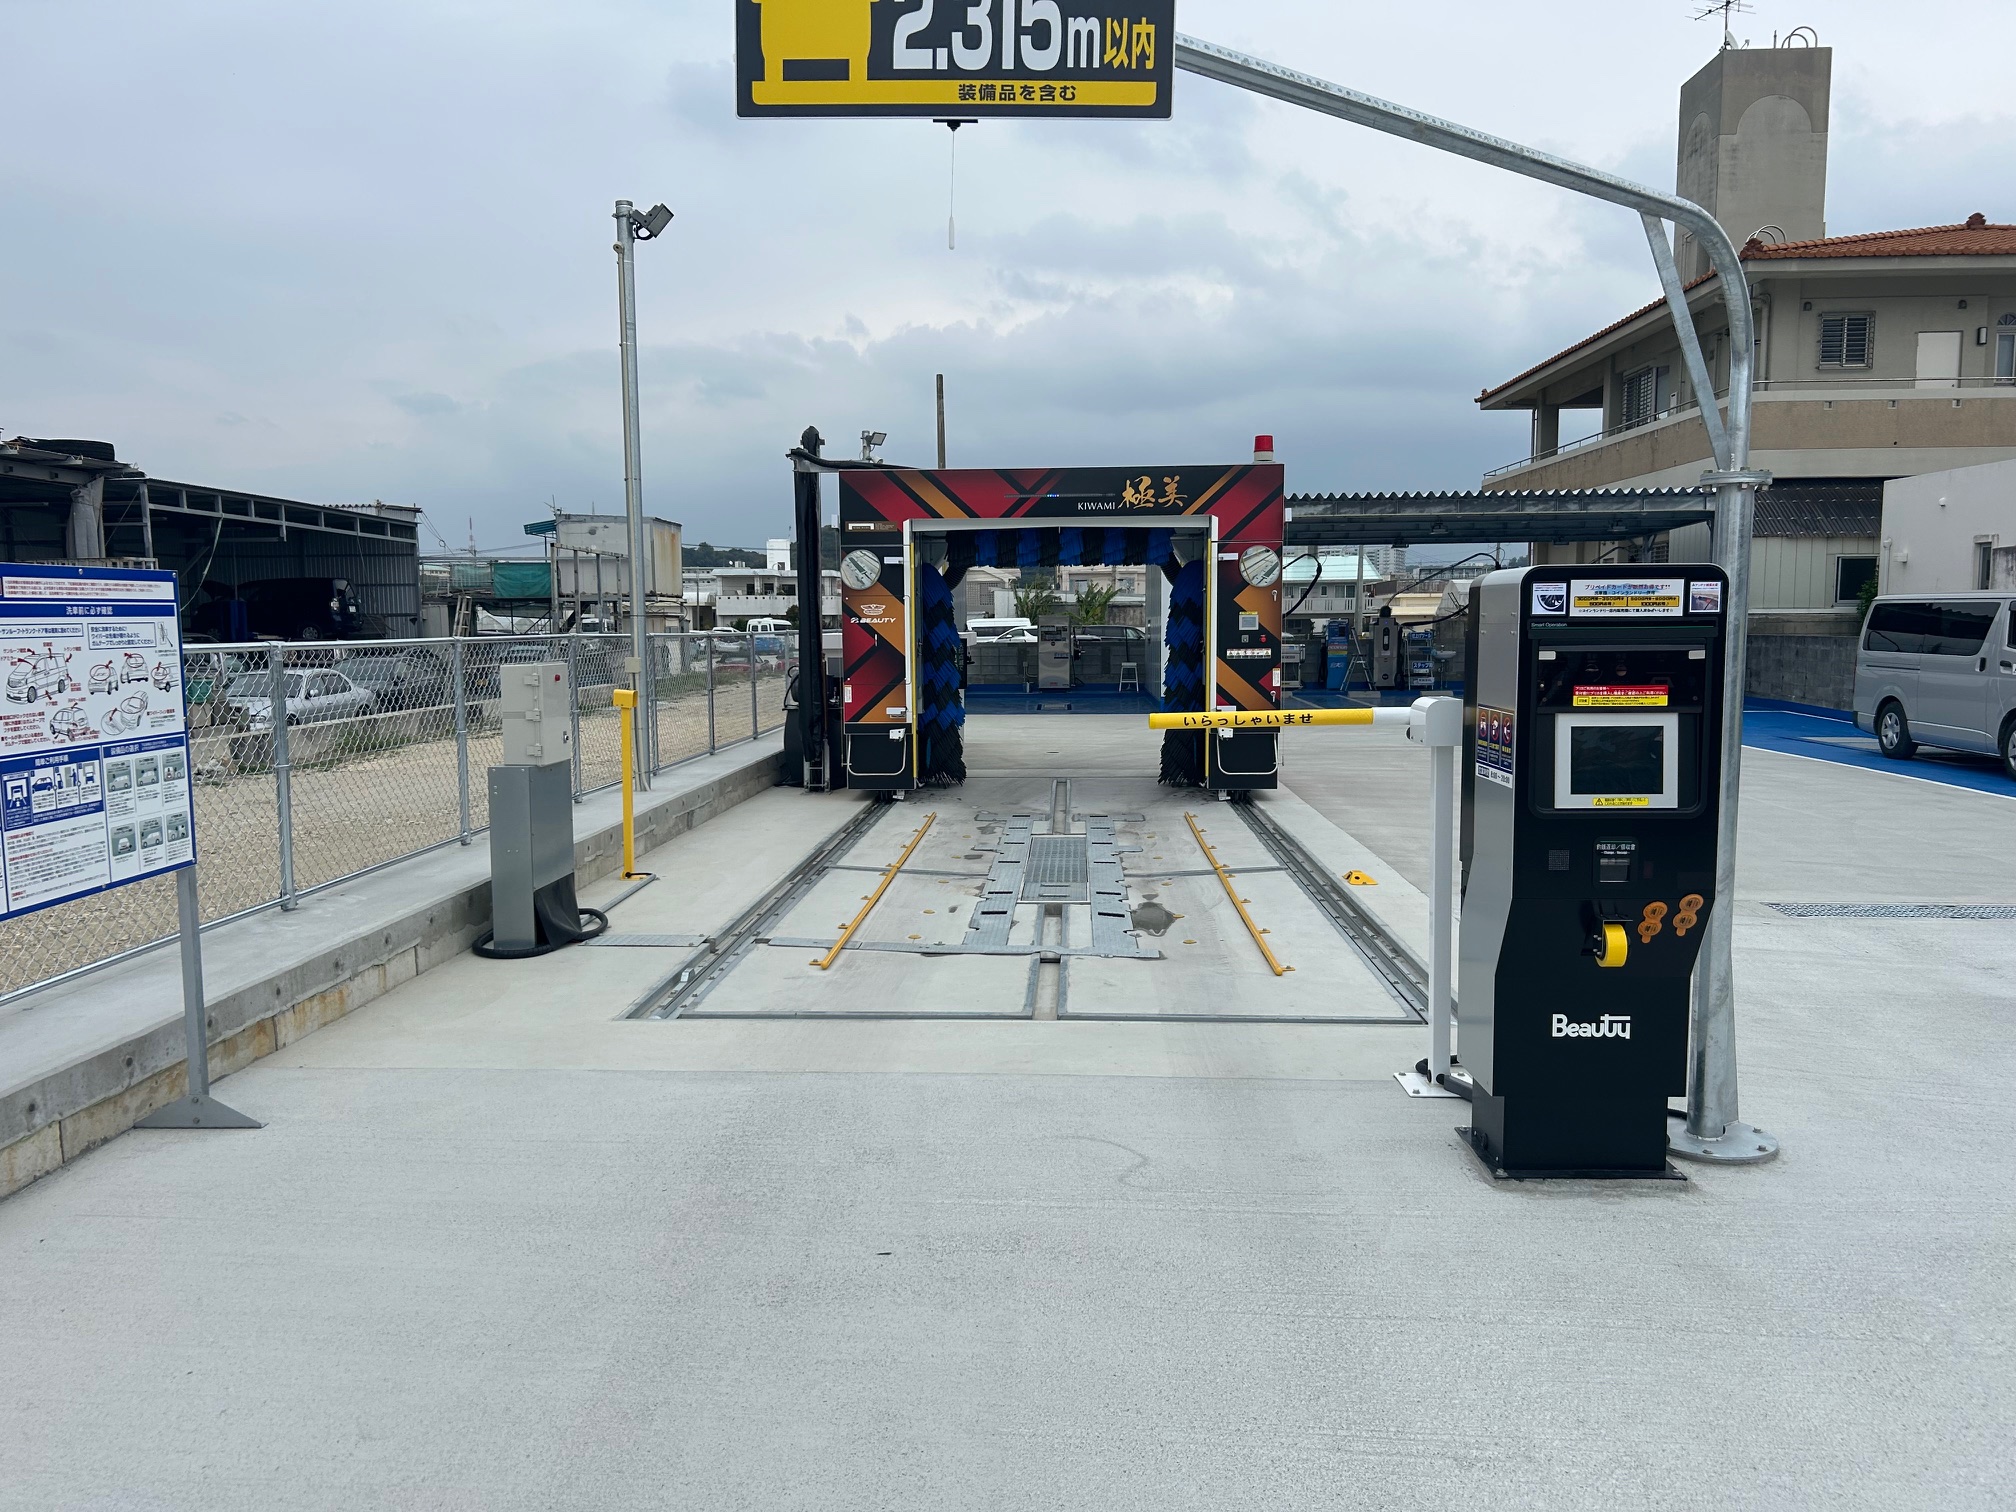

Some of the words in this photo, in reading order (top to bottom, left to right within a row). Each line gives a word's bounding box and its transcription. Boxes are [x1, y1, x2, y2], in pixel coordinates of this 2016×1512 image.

[958, 83, 1077, 102] 装備品を含む
[1077, 501, 1116, 511] KIWAMI
[1118, 475, 1188, 510] 極美
[65, 606, 114, 616] 洗車前に必ず確認
[1184, 712, 1314, 727] いらっしゃいませ
[1552, 1013, 1631, 1040] Beauty
